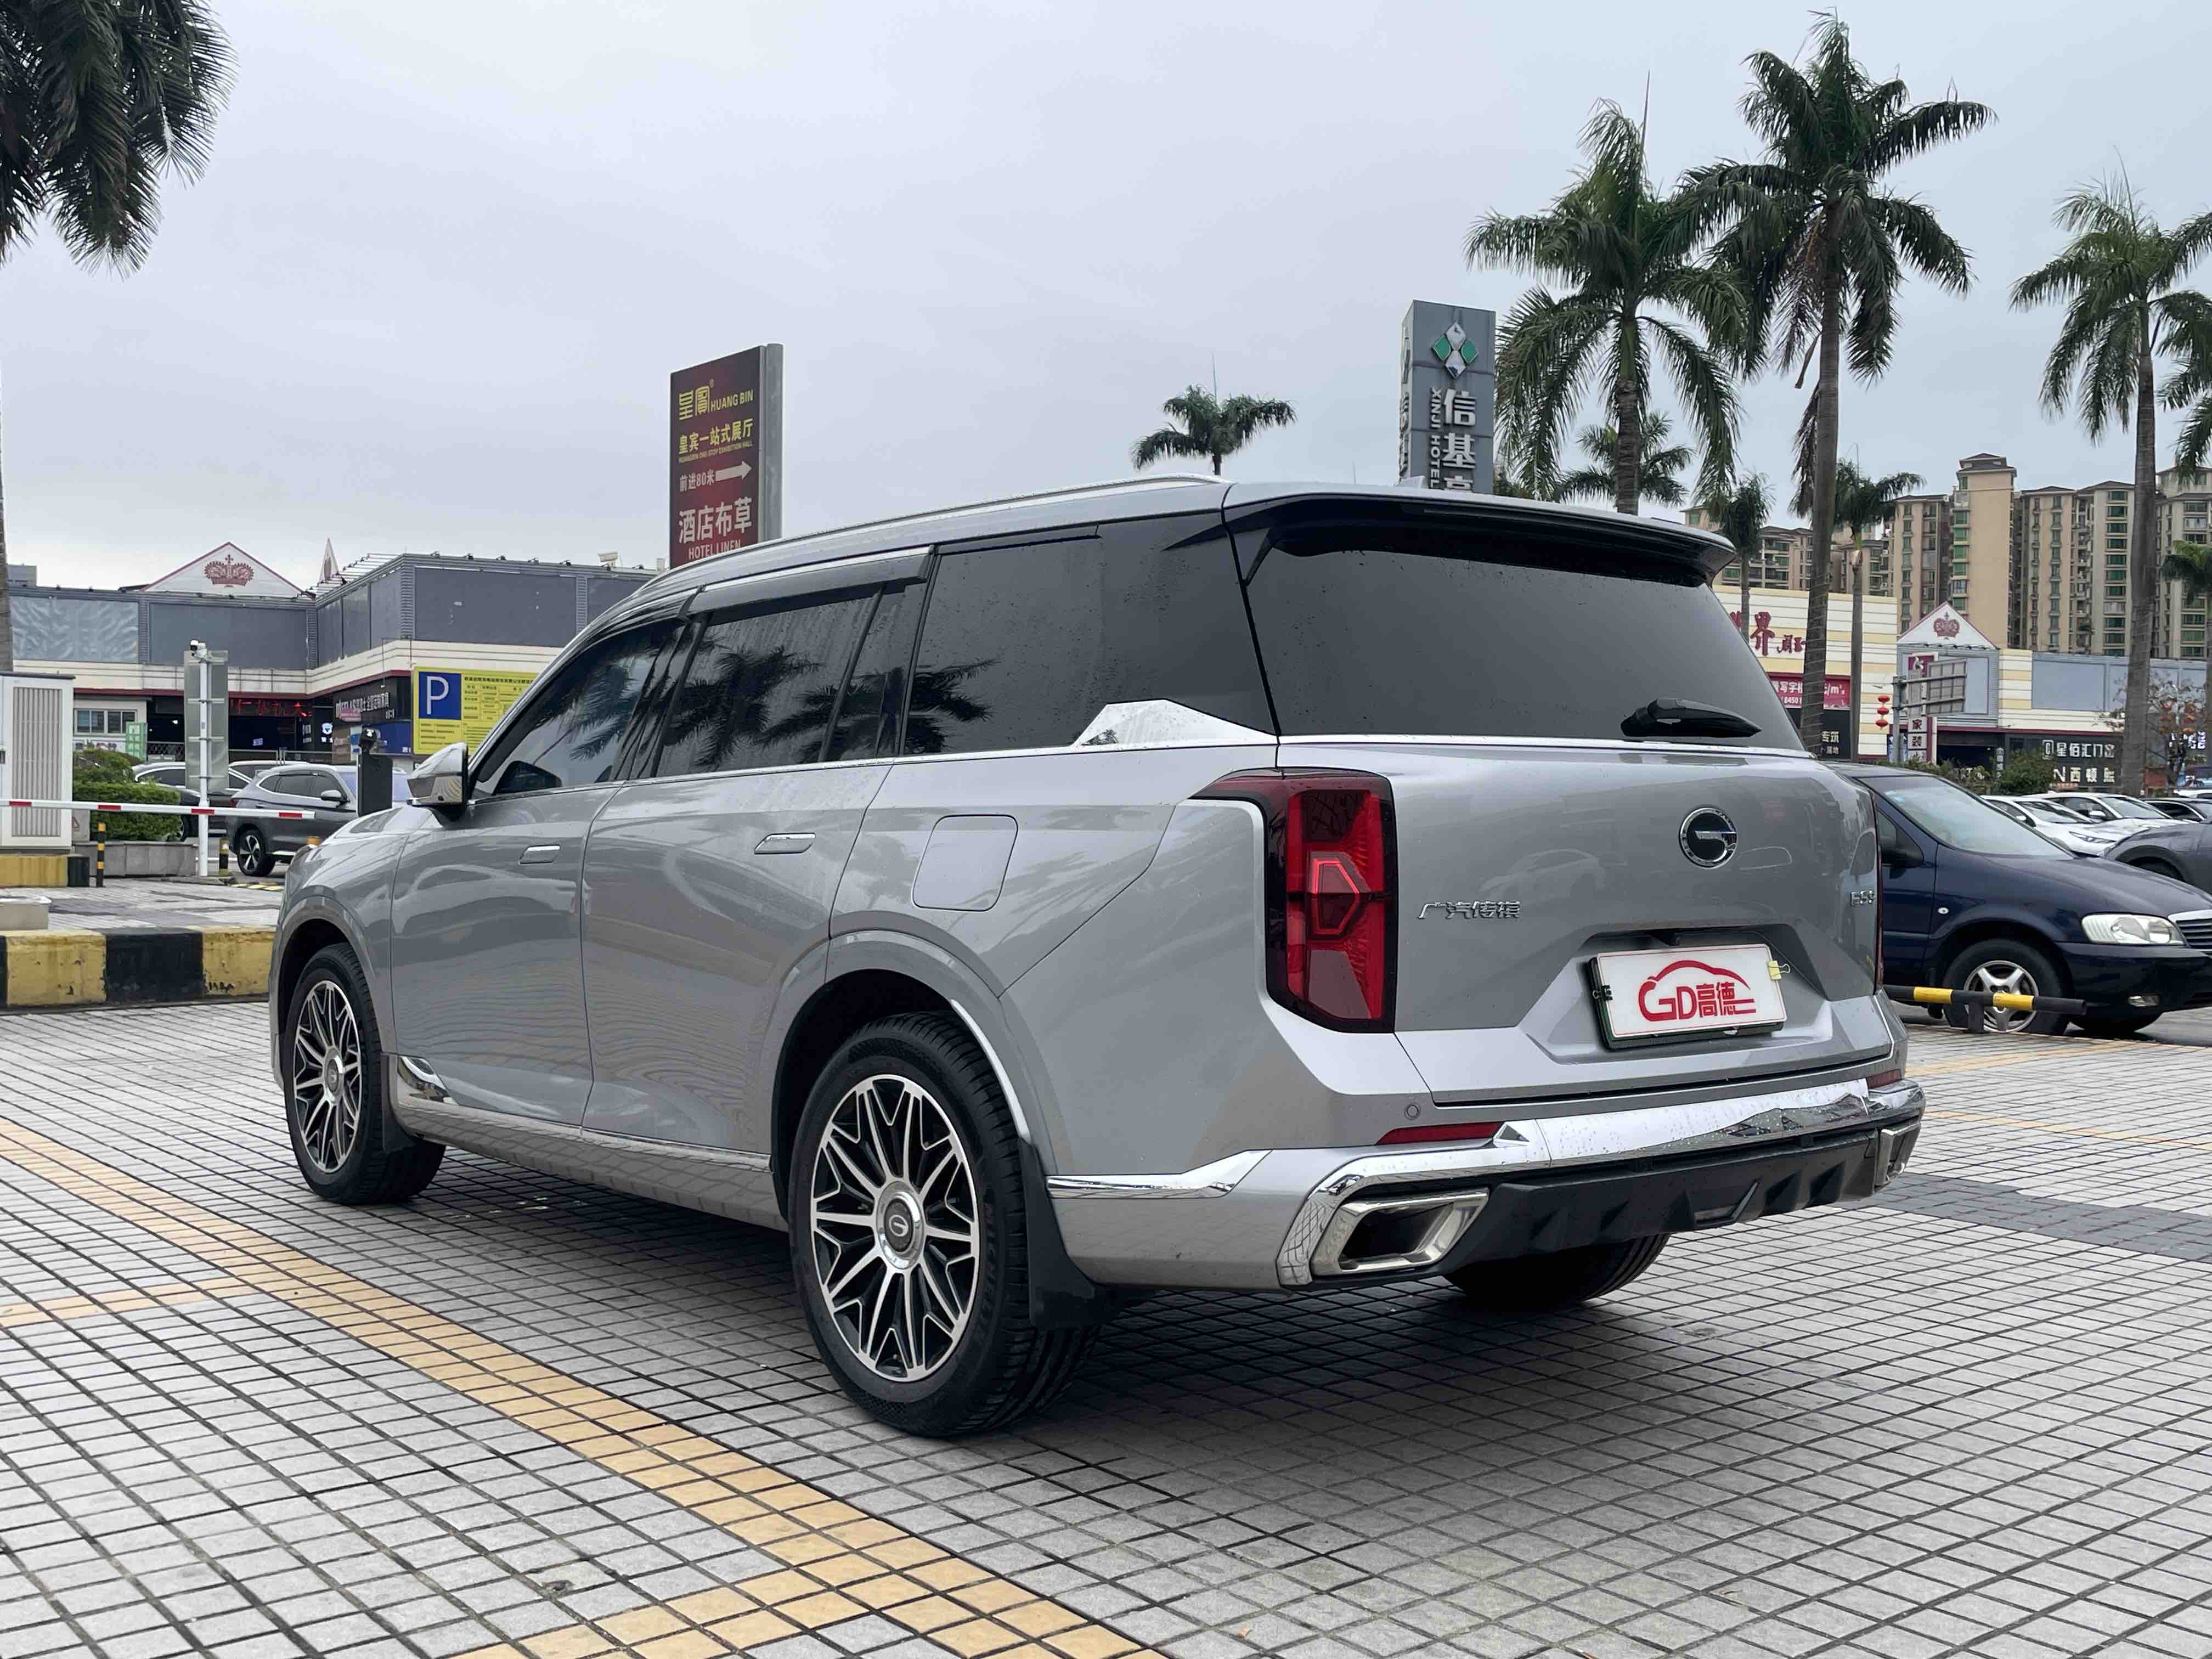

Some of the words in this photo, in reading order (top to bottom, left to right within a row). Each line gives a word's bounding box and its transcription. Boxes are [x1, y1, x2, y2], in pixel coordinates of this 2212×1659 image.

[710, 394, 738, 413] HUANG
[740, 389, 754, 405] BIN
[1430, 387, 1442, 429] XINJI
[679, 418, 754, 454] 皇宾一站式展厅
[1430, 435, 1442, 488] HOTEL
[679, 496, 753, 544] 酒店布草
[427, 676, 449, 715] P
[1418, 901, 1520, 919] 广汽传祺
